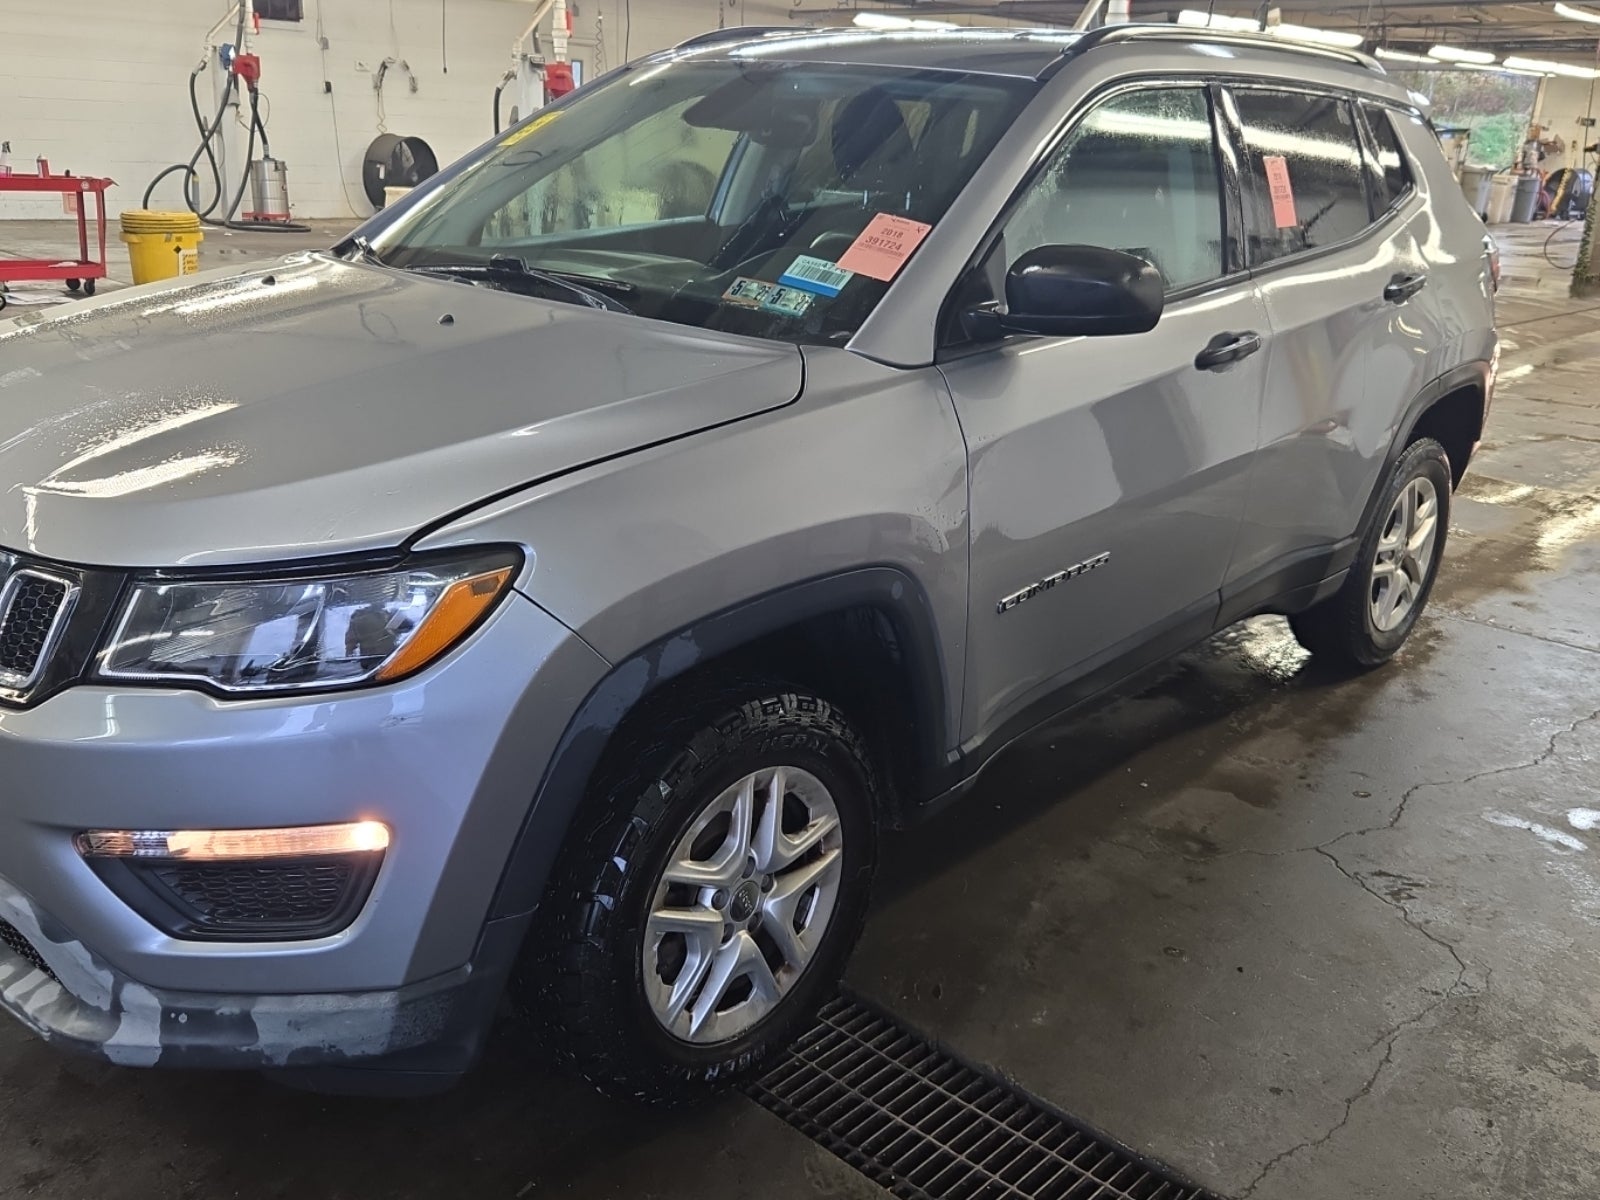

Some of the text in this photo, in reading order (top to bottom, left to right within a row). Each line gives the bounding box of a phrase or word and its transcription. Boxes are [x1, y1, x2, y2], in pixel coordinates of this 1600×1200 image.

[880, 227, 904, 239] 2018
[865, 235, 903, 251] 391724
[997, 551, 1111, 615] COMPASS
